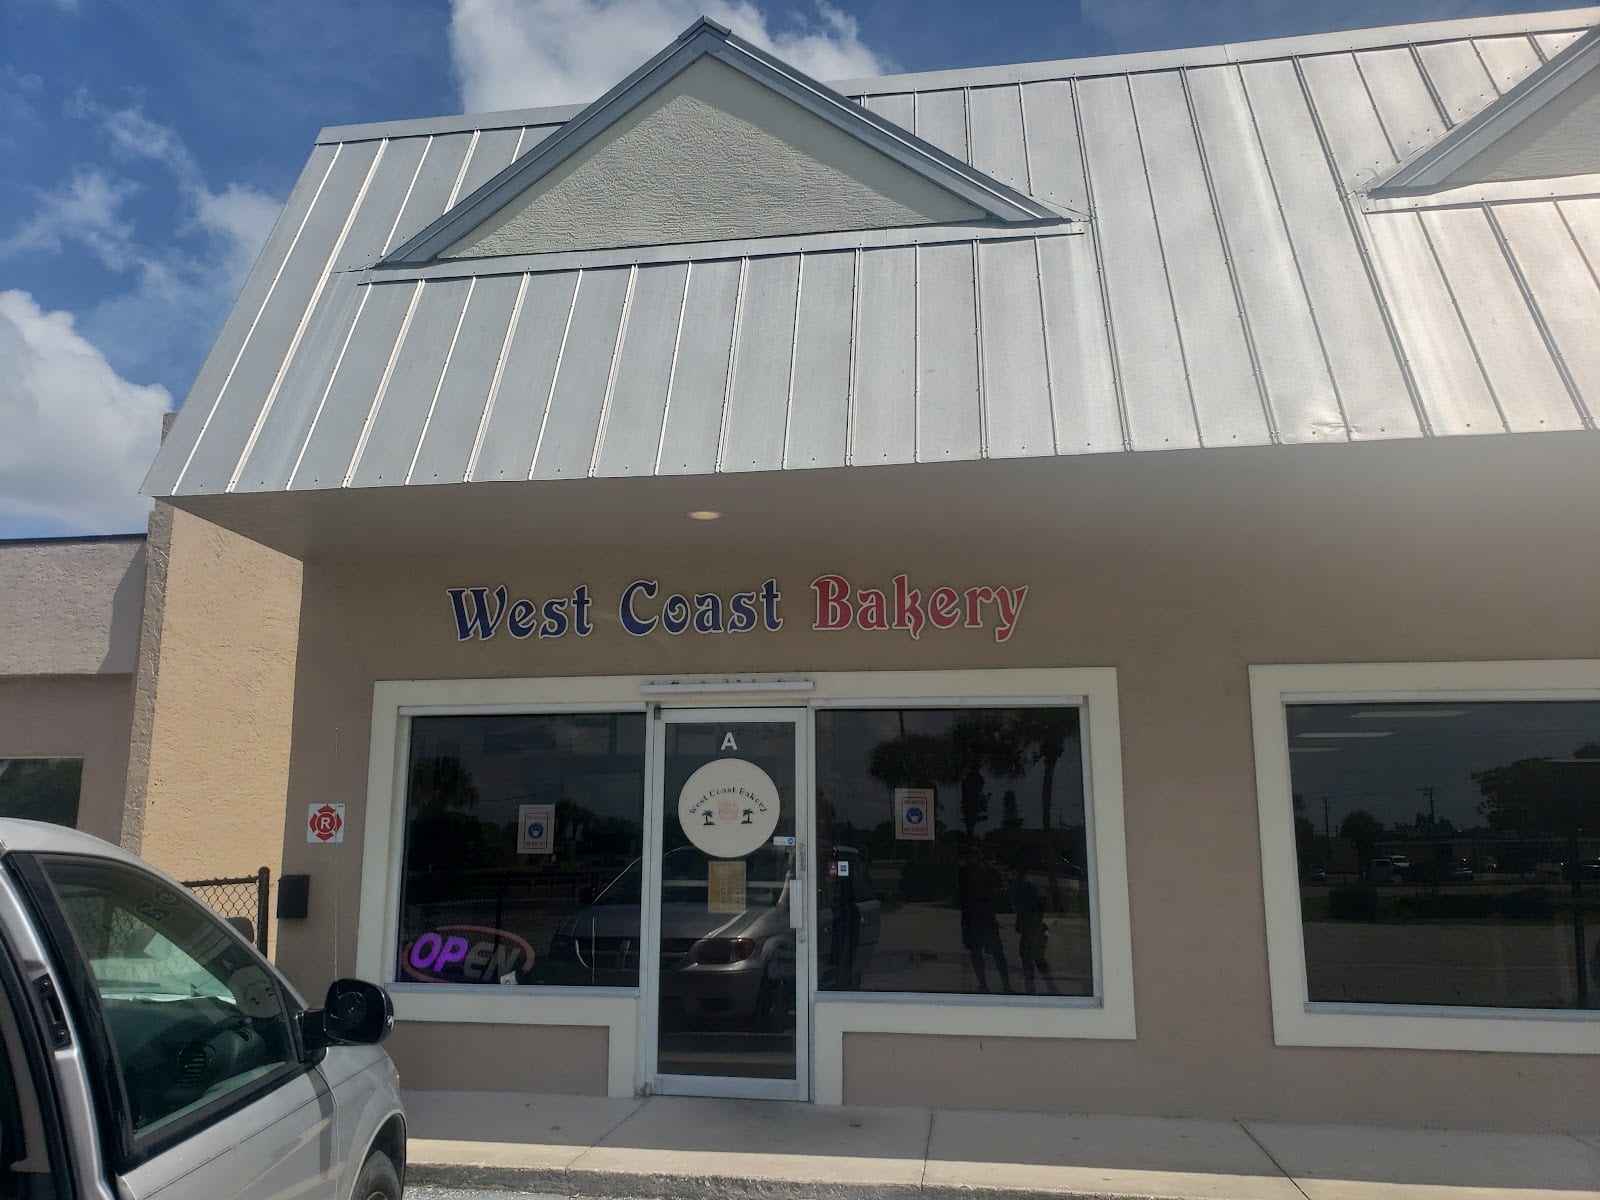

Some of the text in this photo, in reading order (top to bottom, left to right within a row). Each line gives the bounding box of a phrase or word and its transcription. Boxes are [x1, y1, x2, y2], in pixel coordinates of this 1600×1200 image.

[447, 573, 1030, 643] West Coast Bakery
[720, 731, 738, 751] A
[689, 786, 768, 814] West Coast Bakery
[320, 817, 331, 829] R
[410, 932, 522, 982] OPEN
